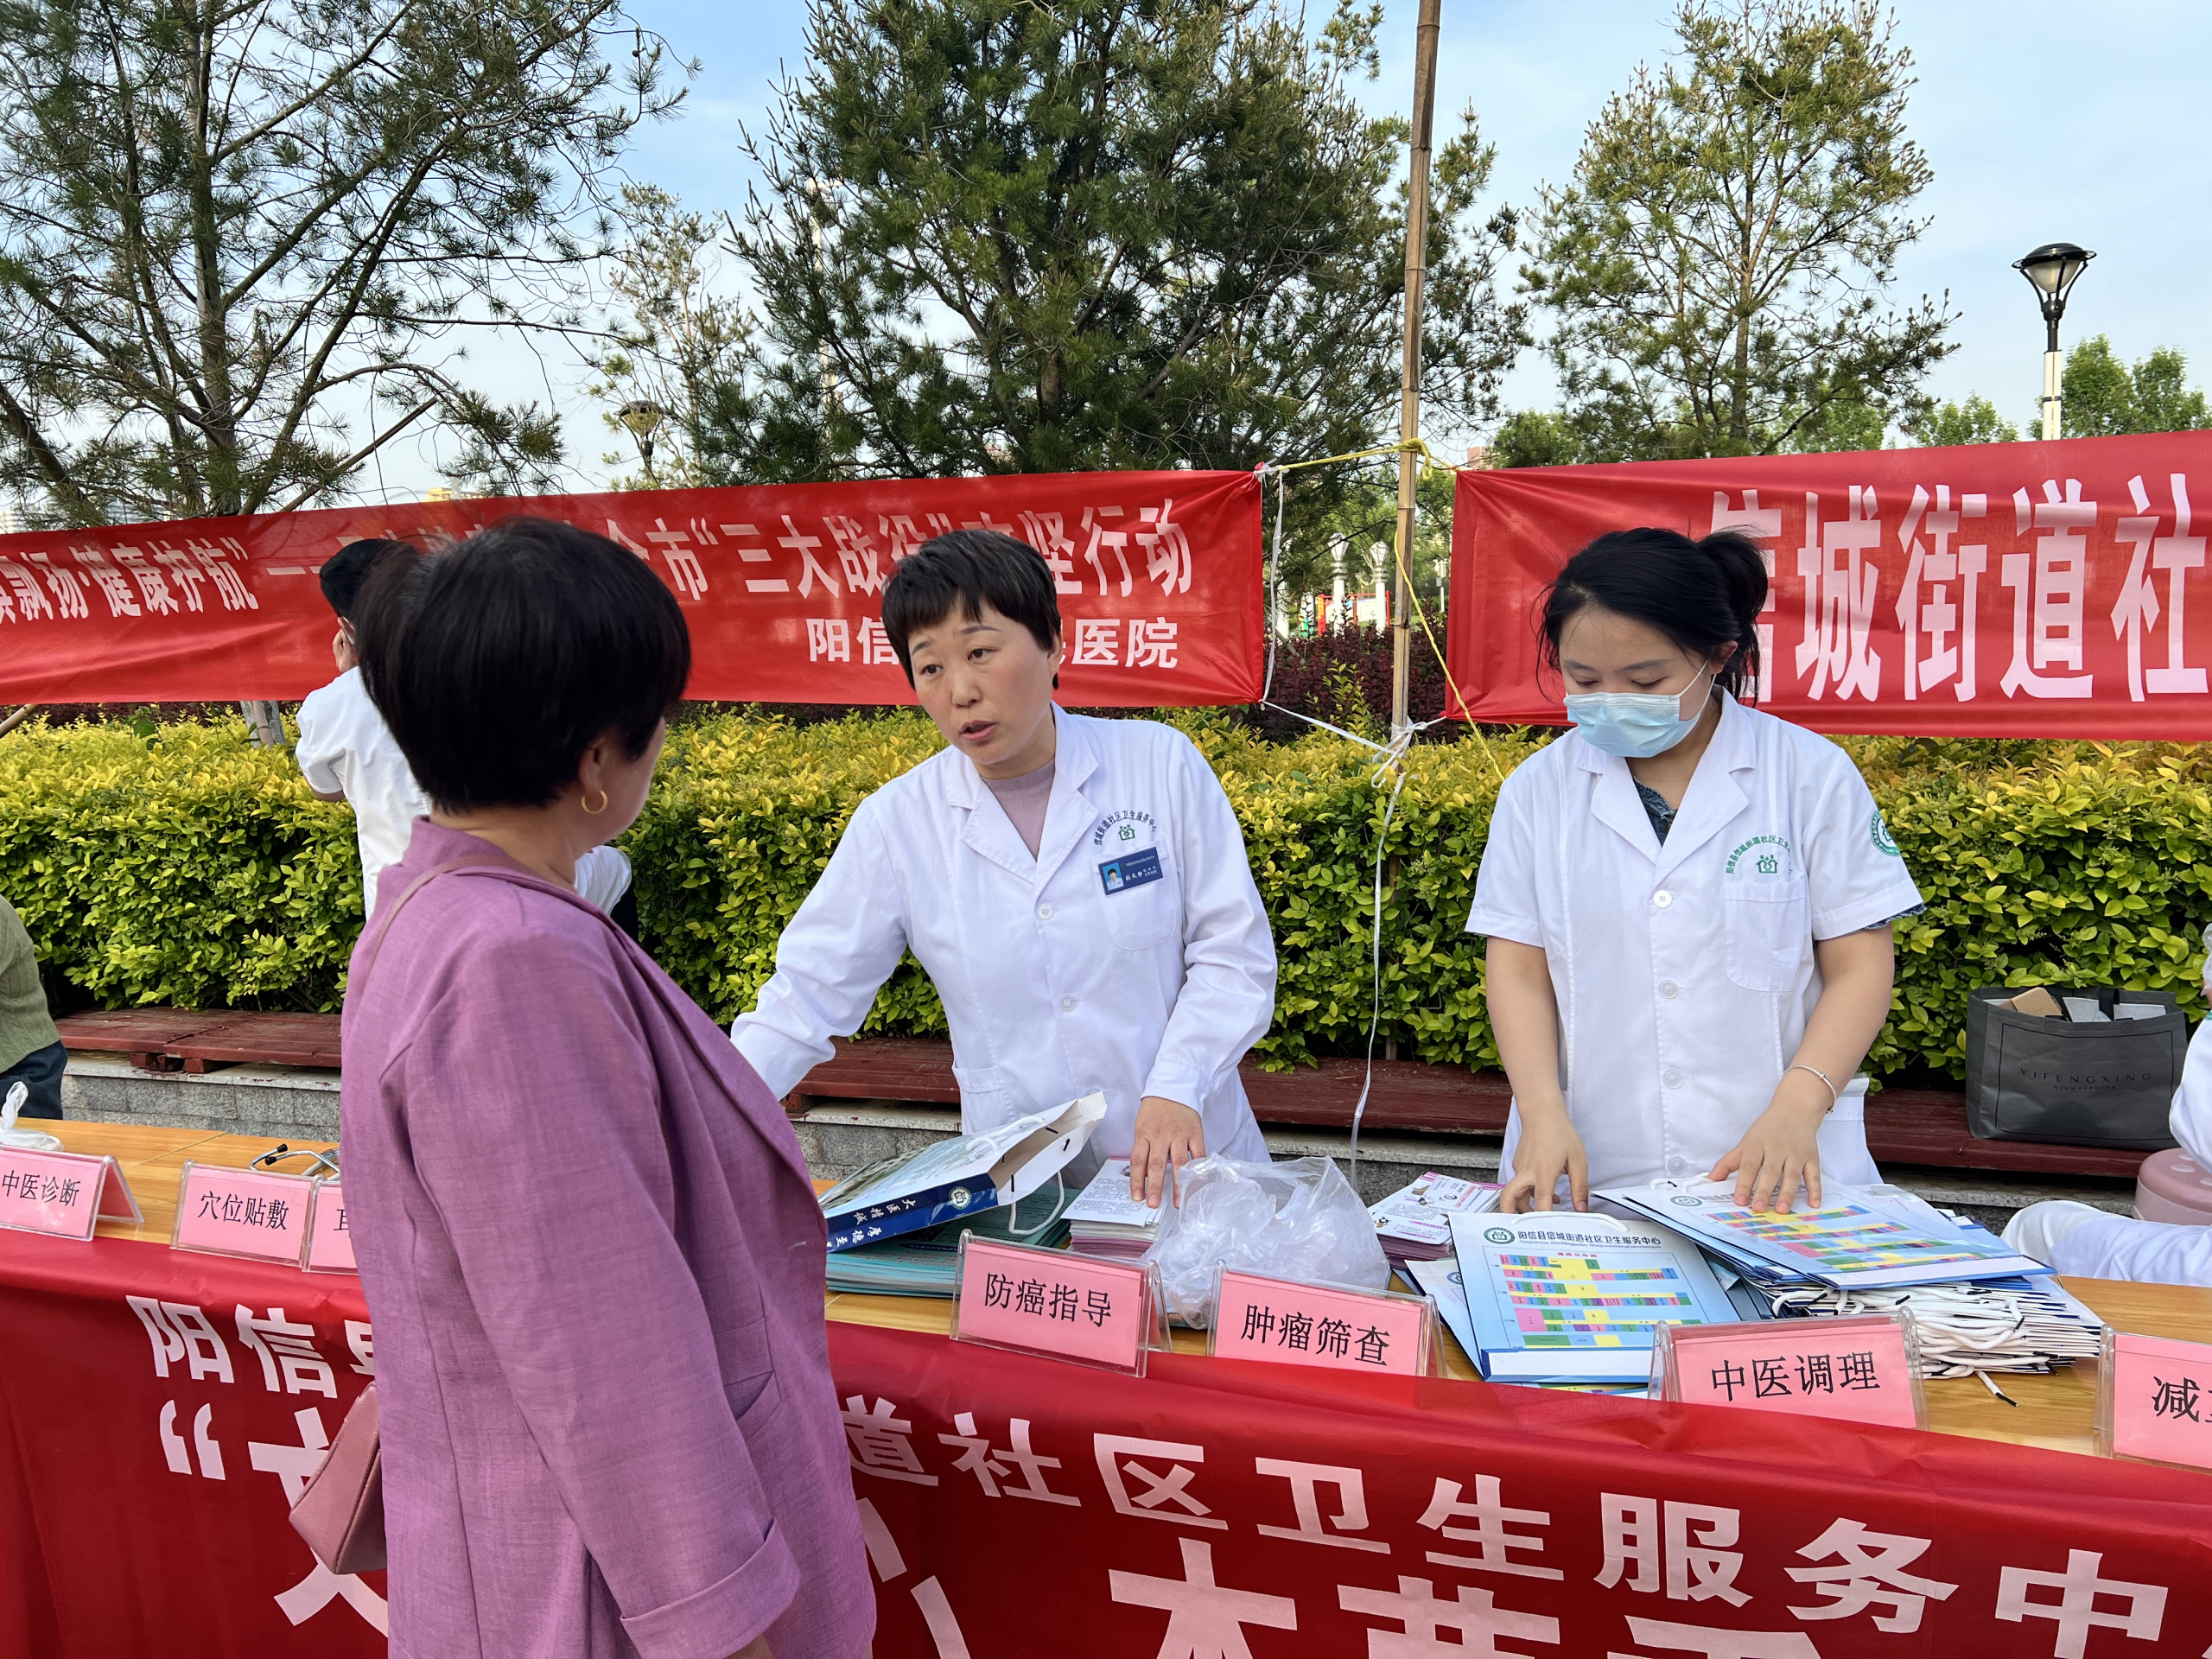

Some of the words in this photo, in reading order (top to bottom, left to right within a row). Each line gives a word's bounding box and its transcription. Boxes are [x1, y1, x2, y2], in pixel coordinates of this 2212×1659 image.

[2020, 1068, 2152, 1084] YIFENGXING
[2, 1169, 81, 1207] 中医诊断
[200, 1191, 289, 1230] 穴位贴敷
[1517, 1230, 1662, 1245] 阳信县信城街道社区卫生服务中心
[984, 1272, 1112, 1328] 防癌指导
[1241, 1303, 1390, 1366] 肿瘤筛查
[1710, 1351, 1881, 1402] 中医调理
